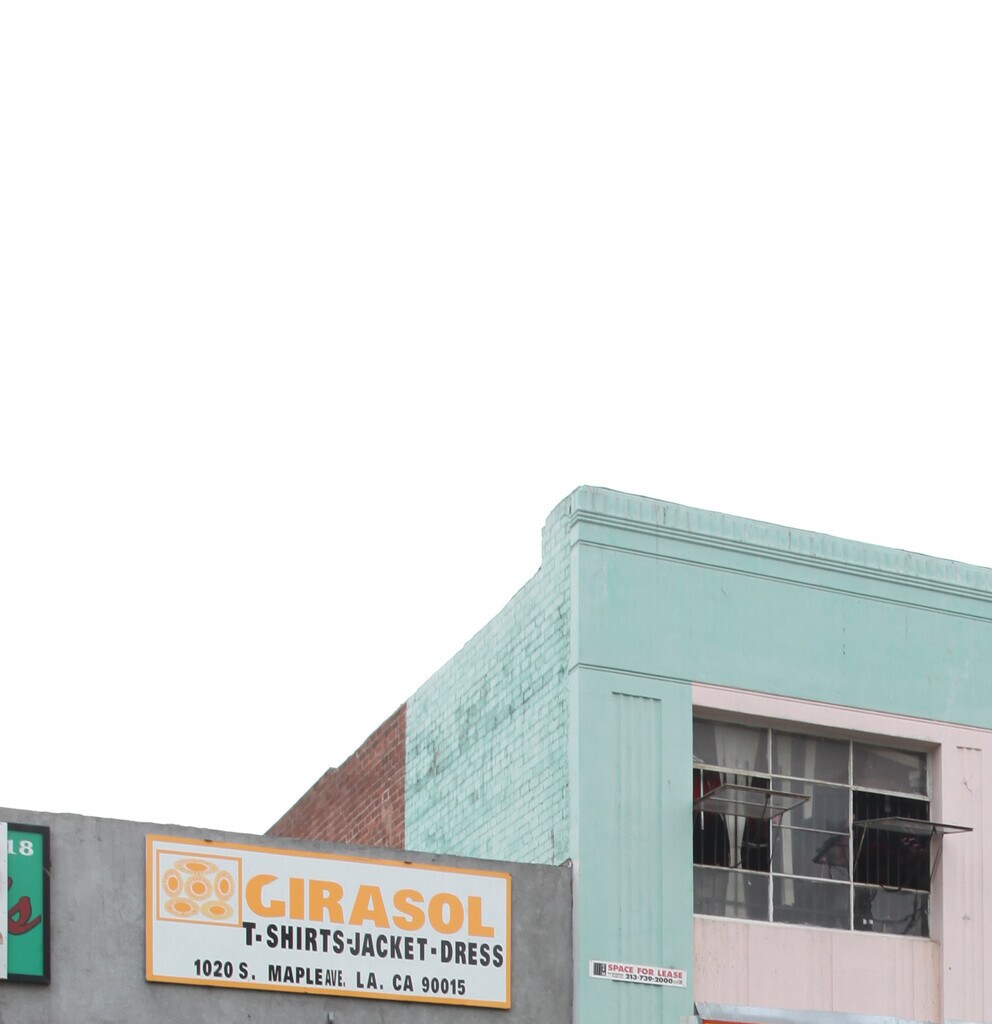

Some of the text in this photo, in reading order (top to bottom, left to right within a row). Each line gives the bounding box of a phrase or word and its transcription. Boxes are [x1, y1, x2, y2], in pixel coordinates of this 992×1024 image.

[245, 874, 494, 938] GIRASOL
[194, 959, 233, 978] 1020
[239, 963, 255, 980] S.
[268, 964, 322, 986] MAPLE
[392, 974, 414, 992] CA
[421, 977, 466, 995] 90015
[608, 964, 633, 973] SPACE
[637, 967, 654, 976] FOR
[658, 969, 683, 979] LEASE
